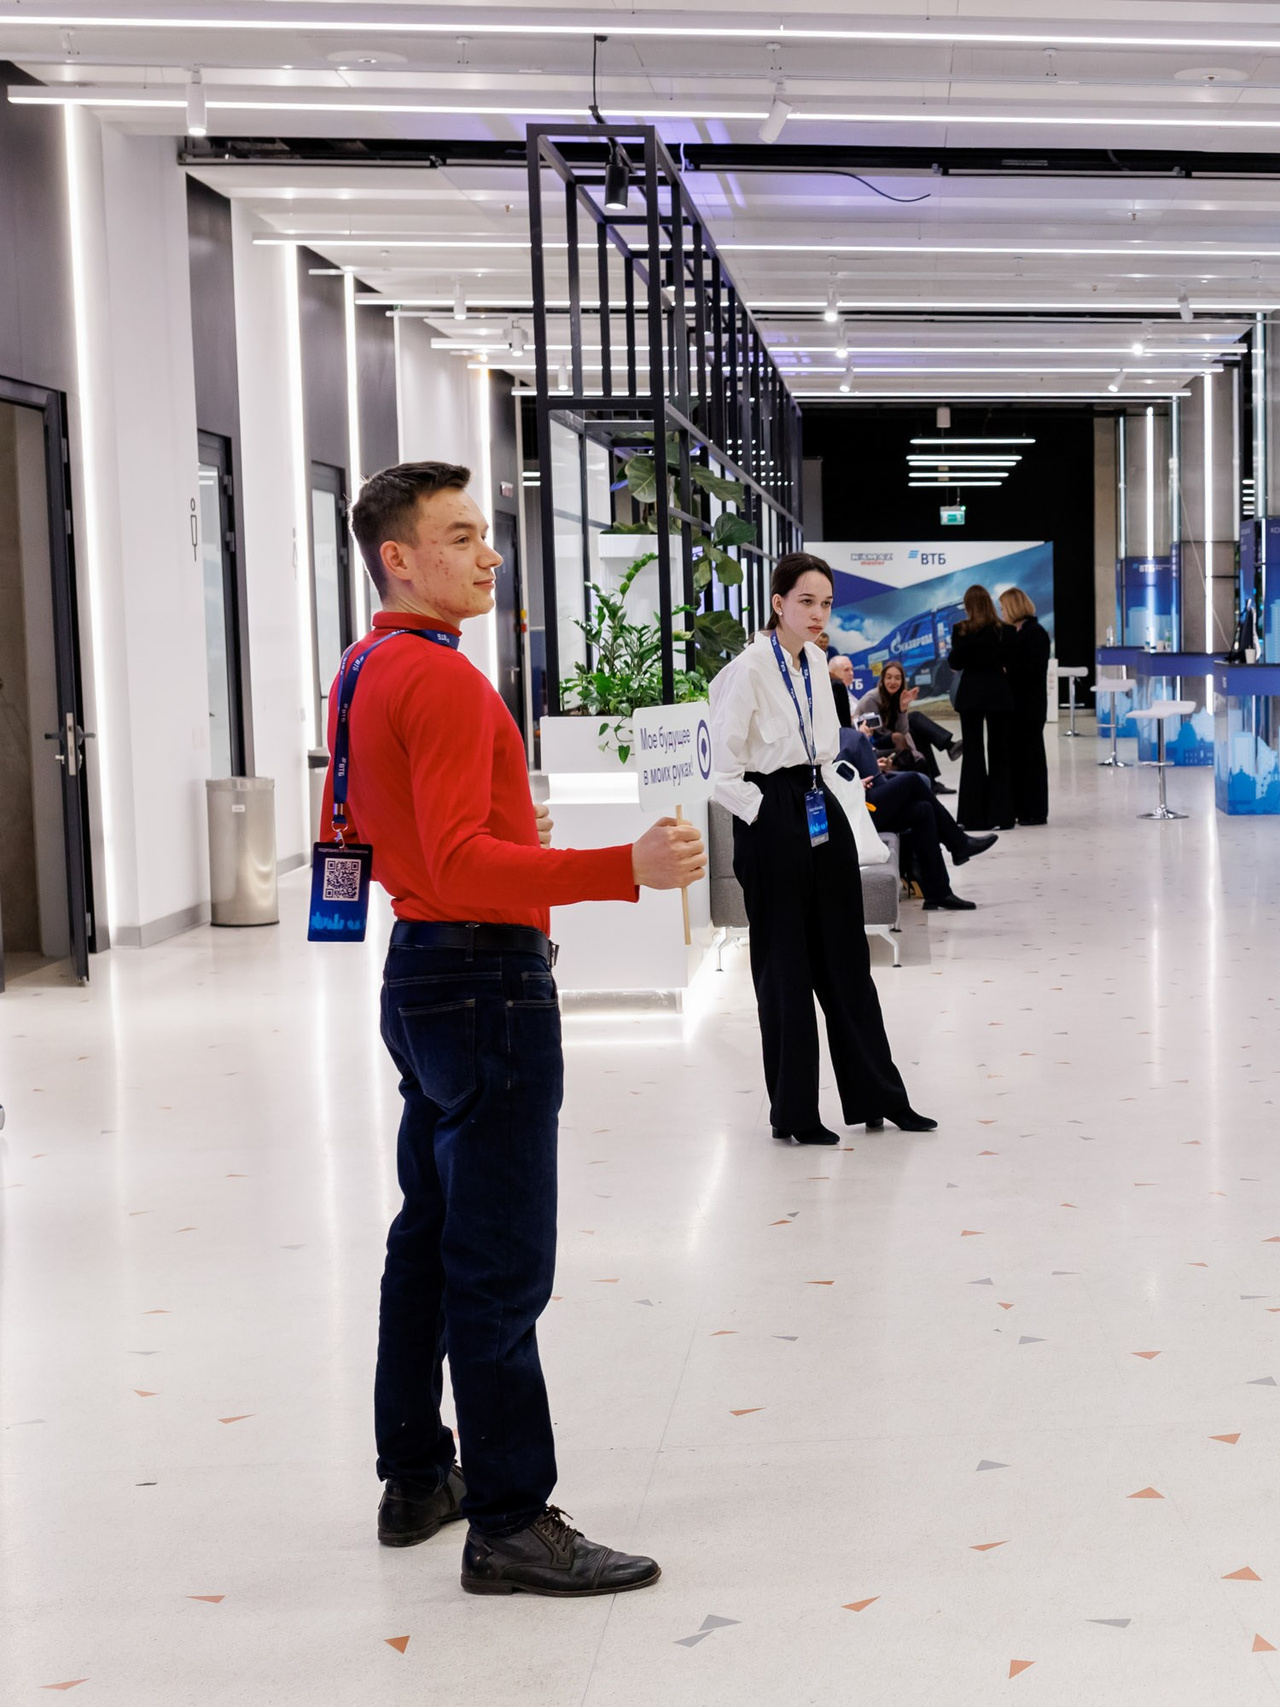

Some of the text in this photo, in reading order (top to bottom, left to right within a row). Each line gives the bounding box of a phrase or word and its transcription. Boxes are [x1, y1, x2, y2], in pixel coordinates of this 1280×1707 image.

[920, 552, 947, 566] ВТБ
[848, 678, 865, 691] ТБ
[640, 725, 691, 754] Мое будущее
[643, 754, 694, 787] в моих руках!
